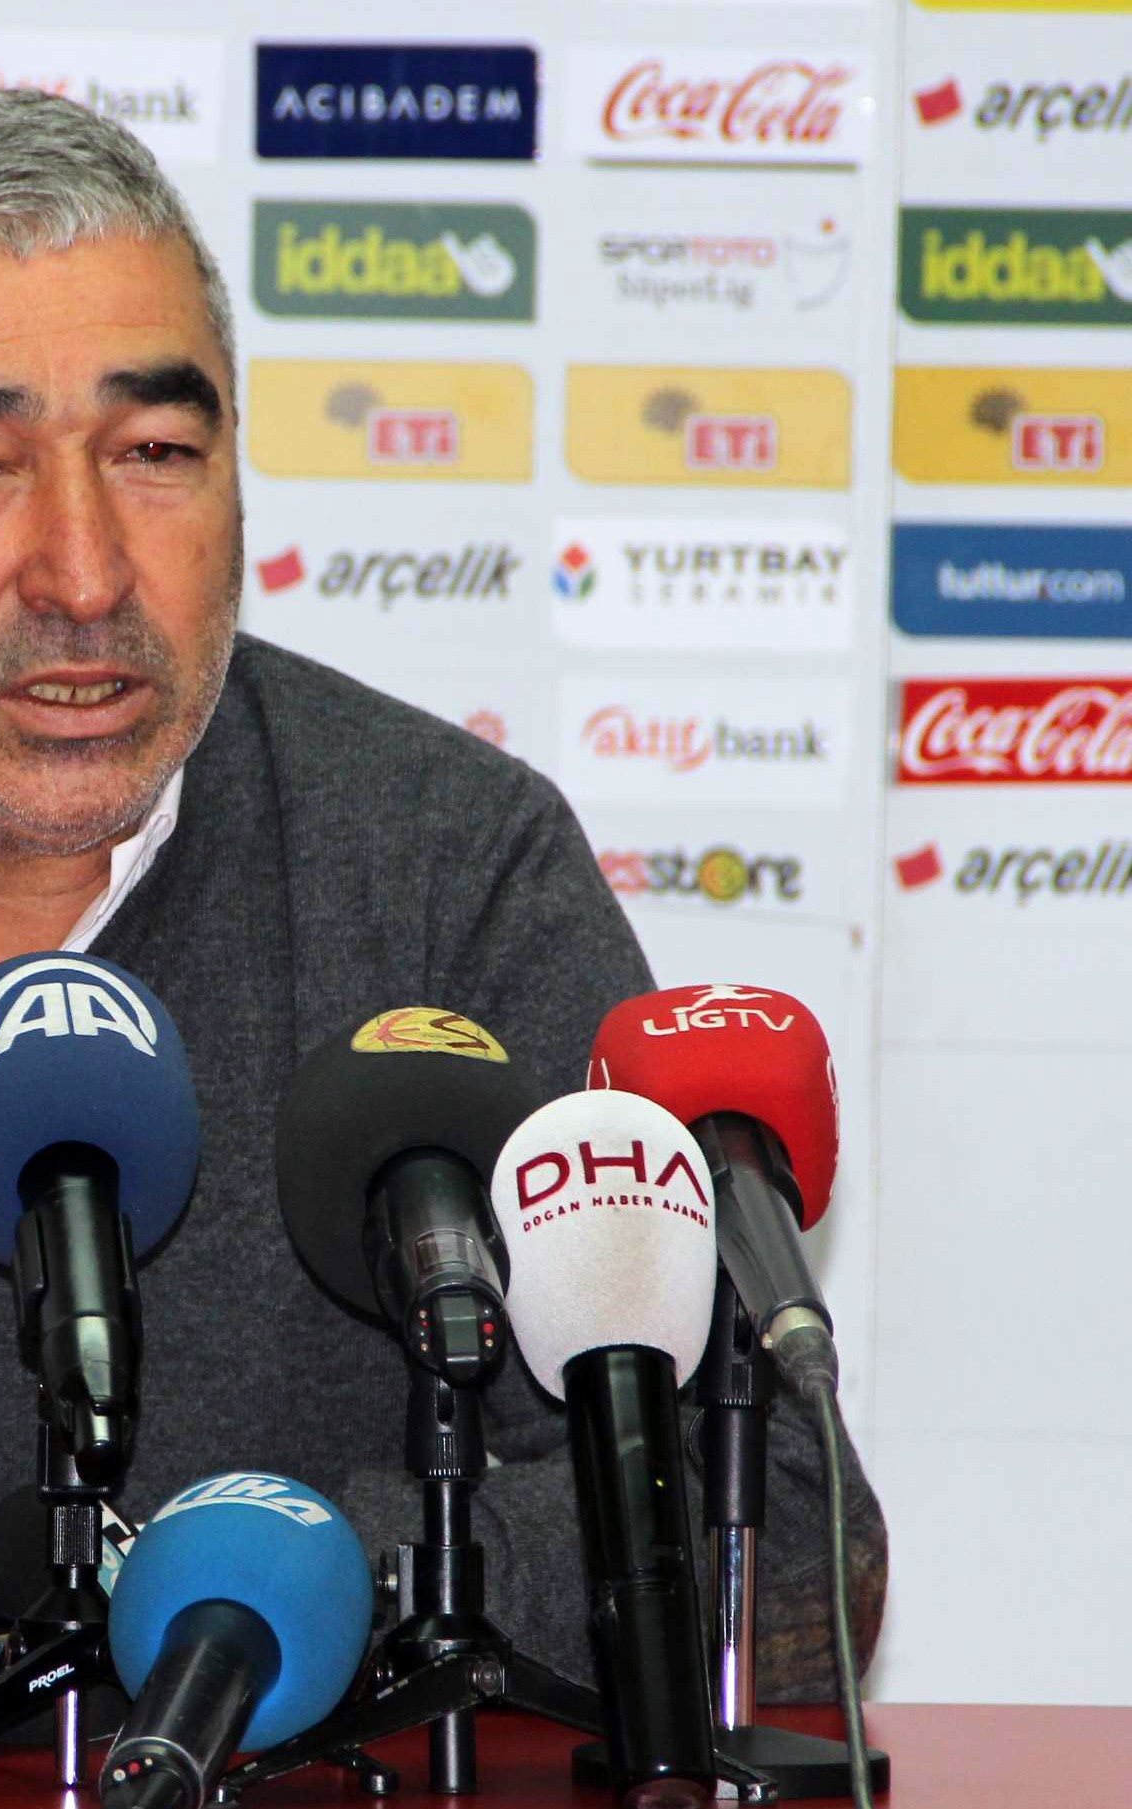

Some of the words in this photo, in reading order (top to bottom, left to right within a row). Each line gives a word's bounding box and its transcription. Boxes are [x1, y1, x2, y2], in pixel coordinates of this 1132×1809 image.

[277, 223, 462, 297] iddaa
[921, 227, 1106, 300] iddaa
[318, 545, 518, 610] arçelik
[623, 544, 848, 574] YURTBAY
[592, 1195, 653, 1206] HABER
[29, 1663, 75, 1693] PROEL
